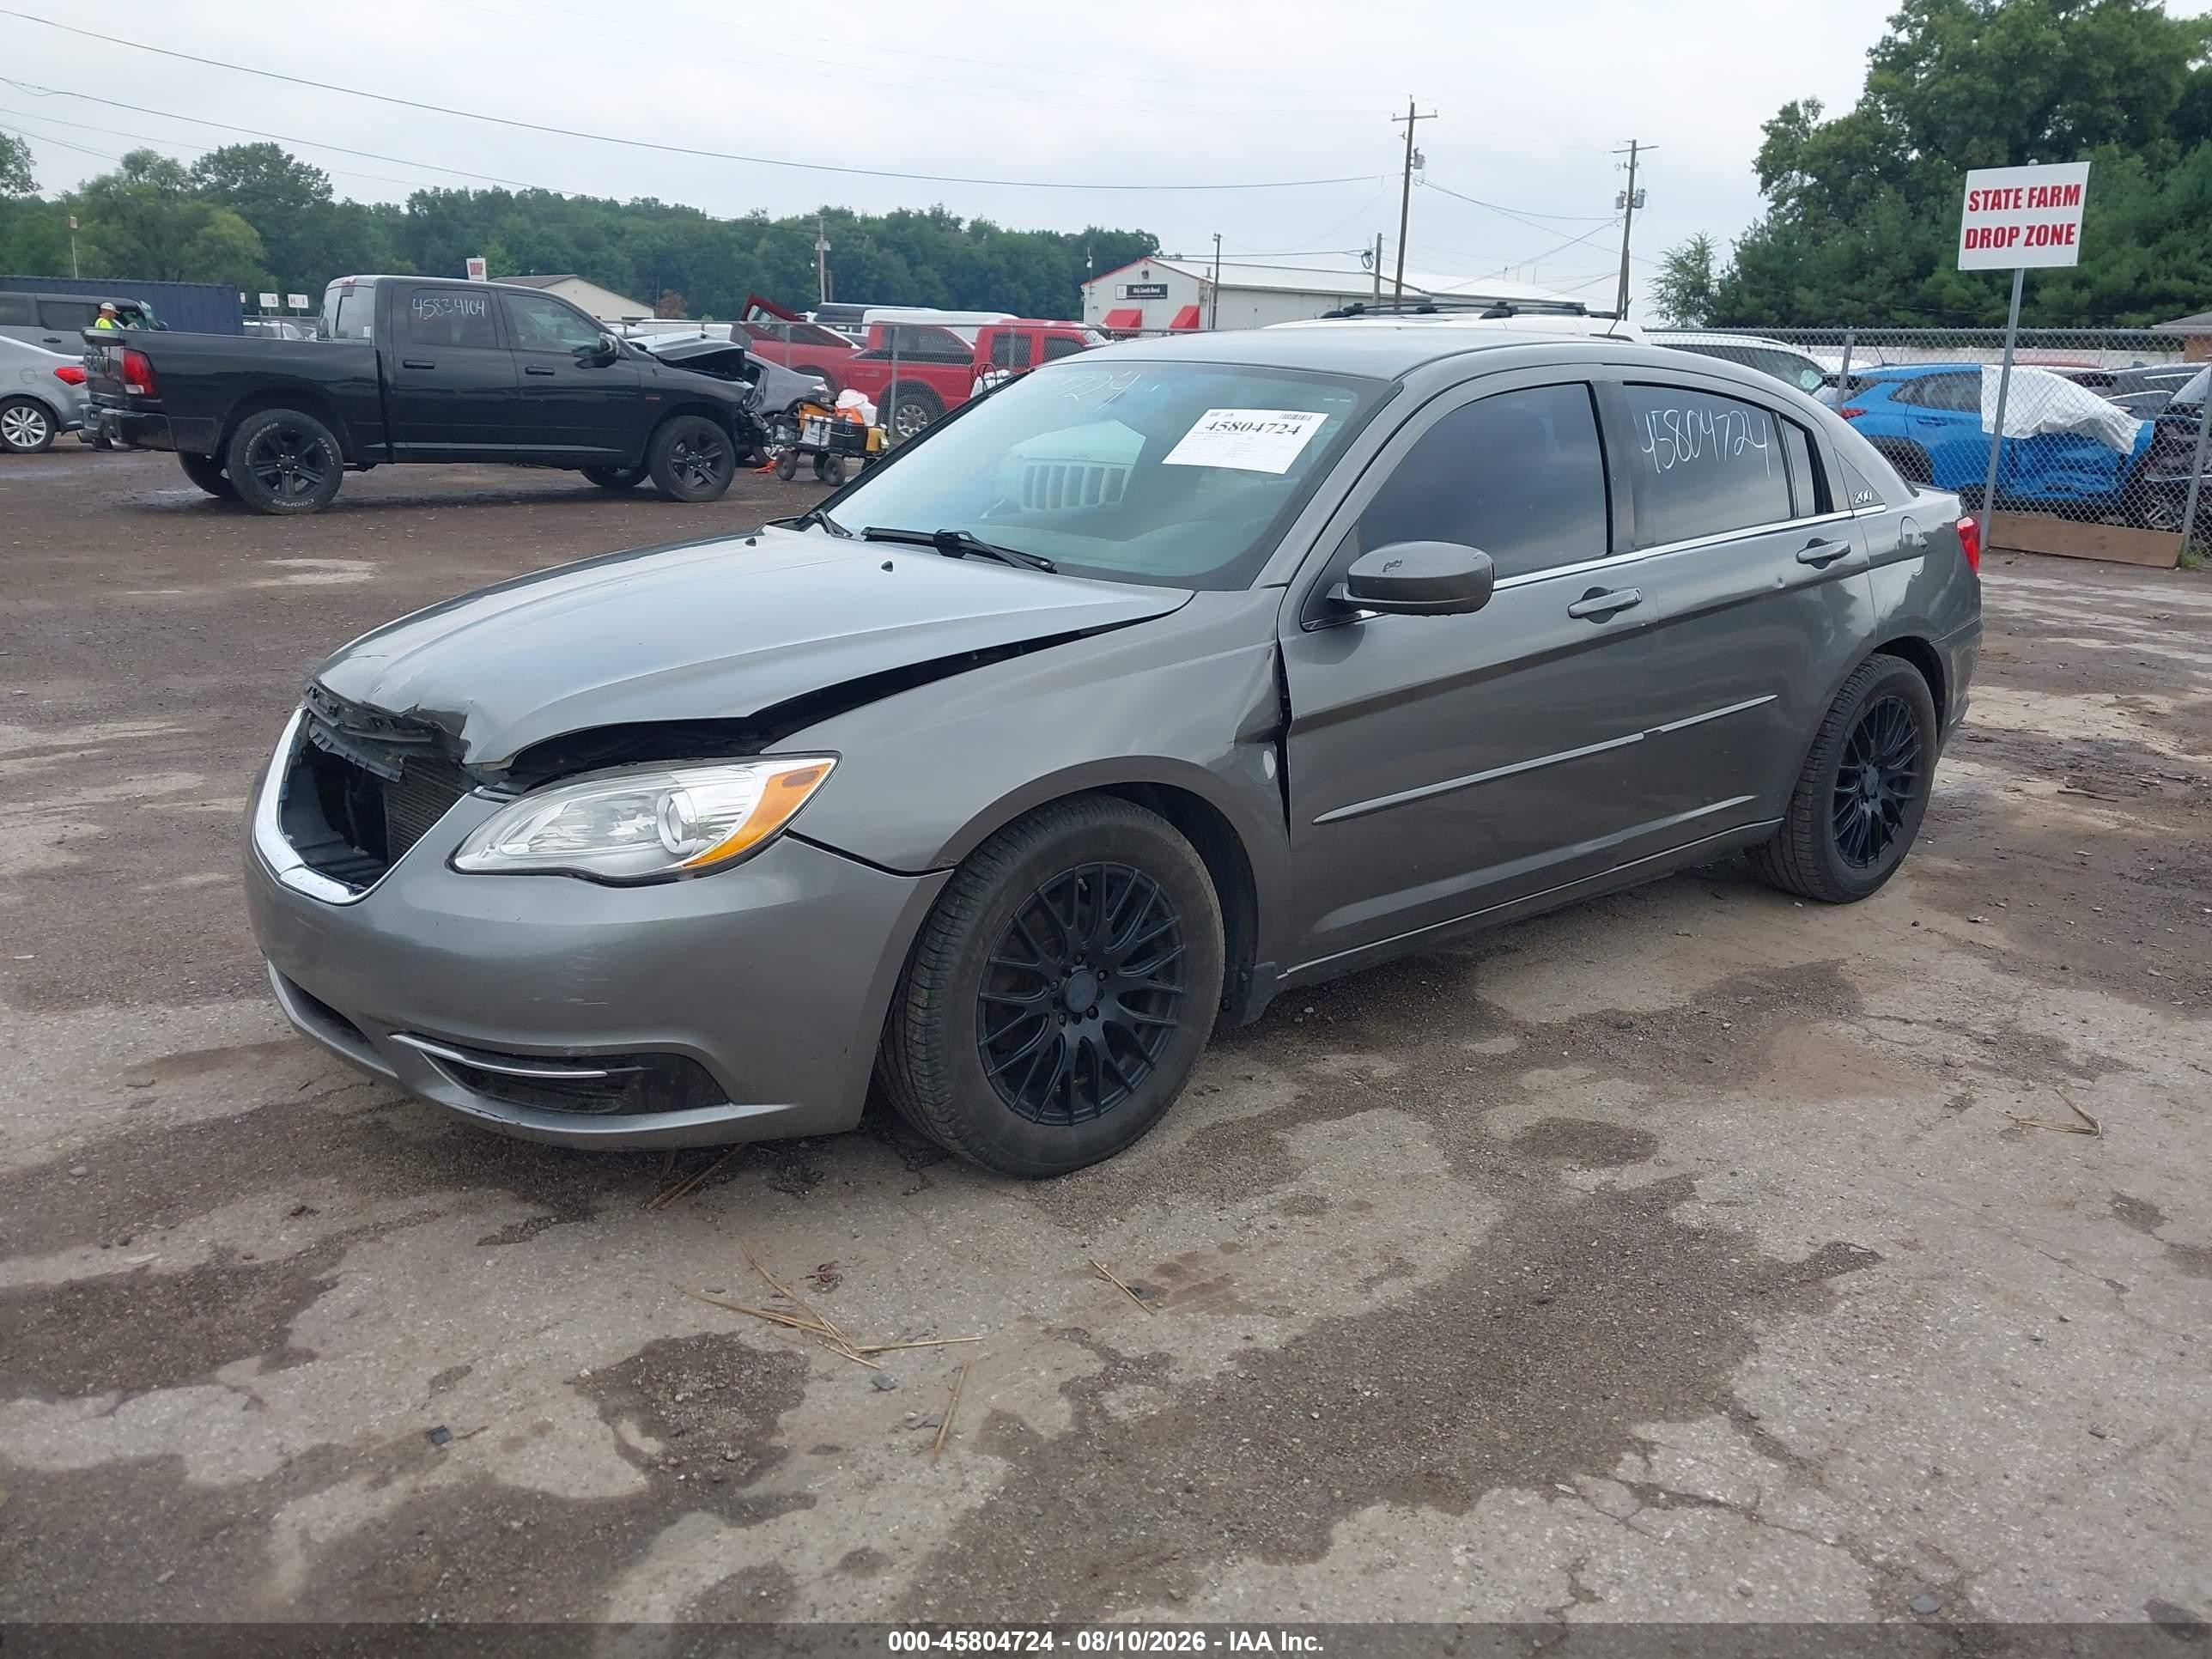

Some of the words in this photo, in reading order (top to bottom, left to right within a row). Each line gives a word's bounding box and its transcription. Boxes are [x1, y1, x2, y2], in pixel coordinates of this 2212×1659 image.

[1968, 187, 2023, 212] STATE
[2027, 183, 2081, 209] FARM
[1964, 226, 2021, 250] DROP
[2023, 223, 2076, 247] ZONE
[412, 298, 485, 319] 45834104
[1205, 420, 1304, 436] 45804724
[1632, 408, 1772, 480] 45804724
[1853, 489, 1873, 504] 200
